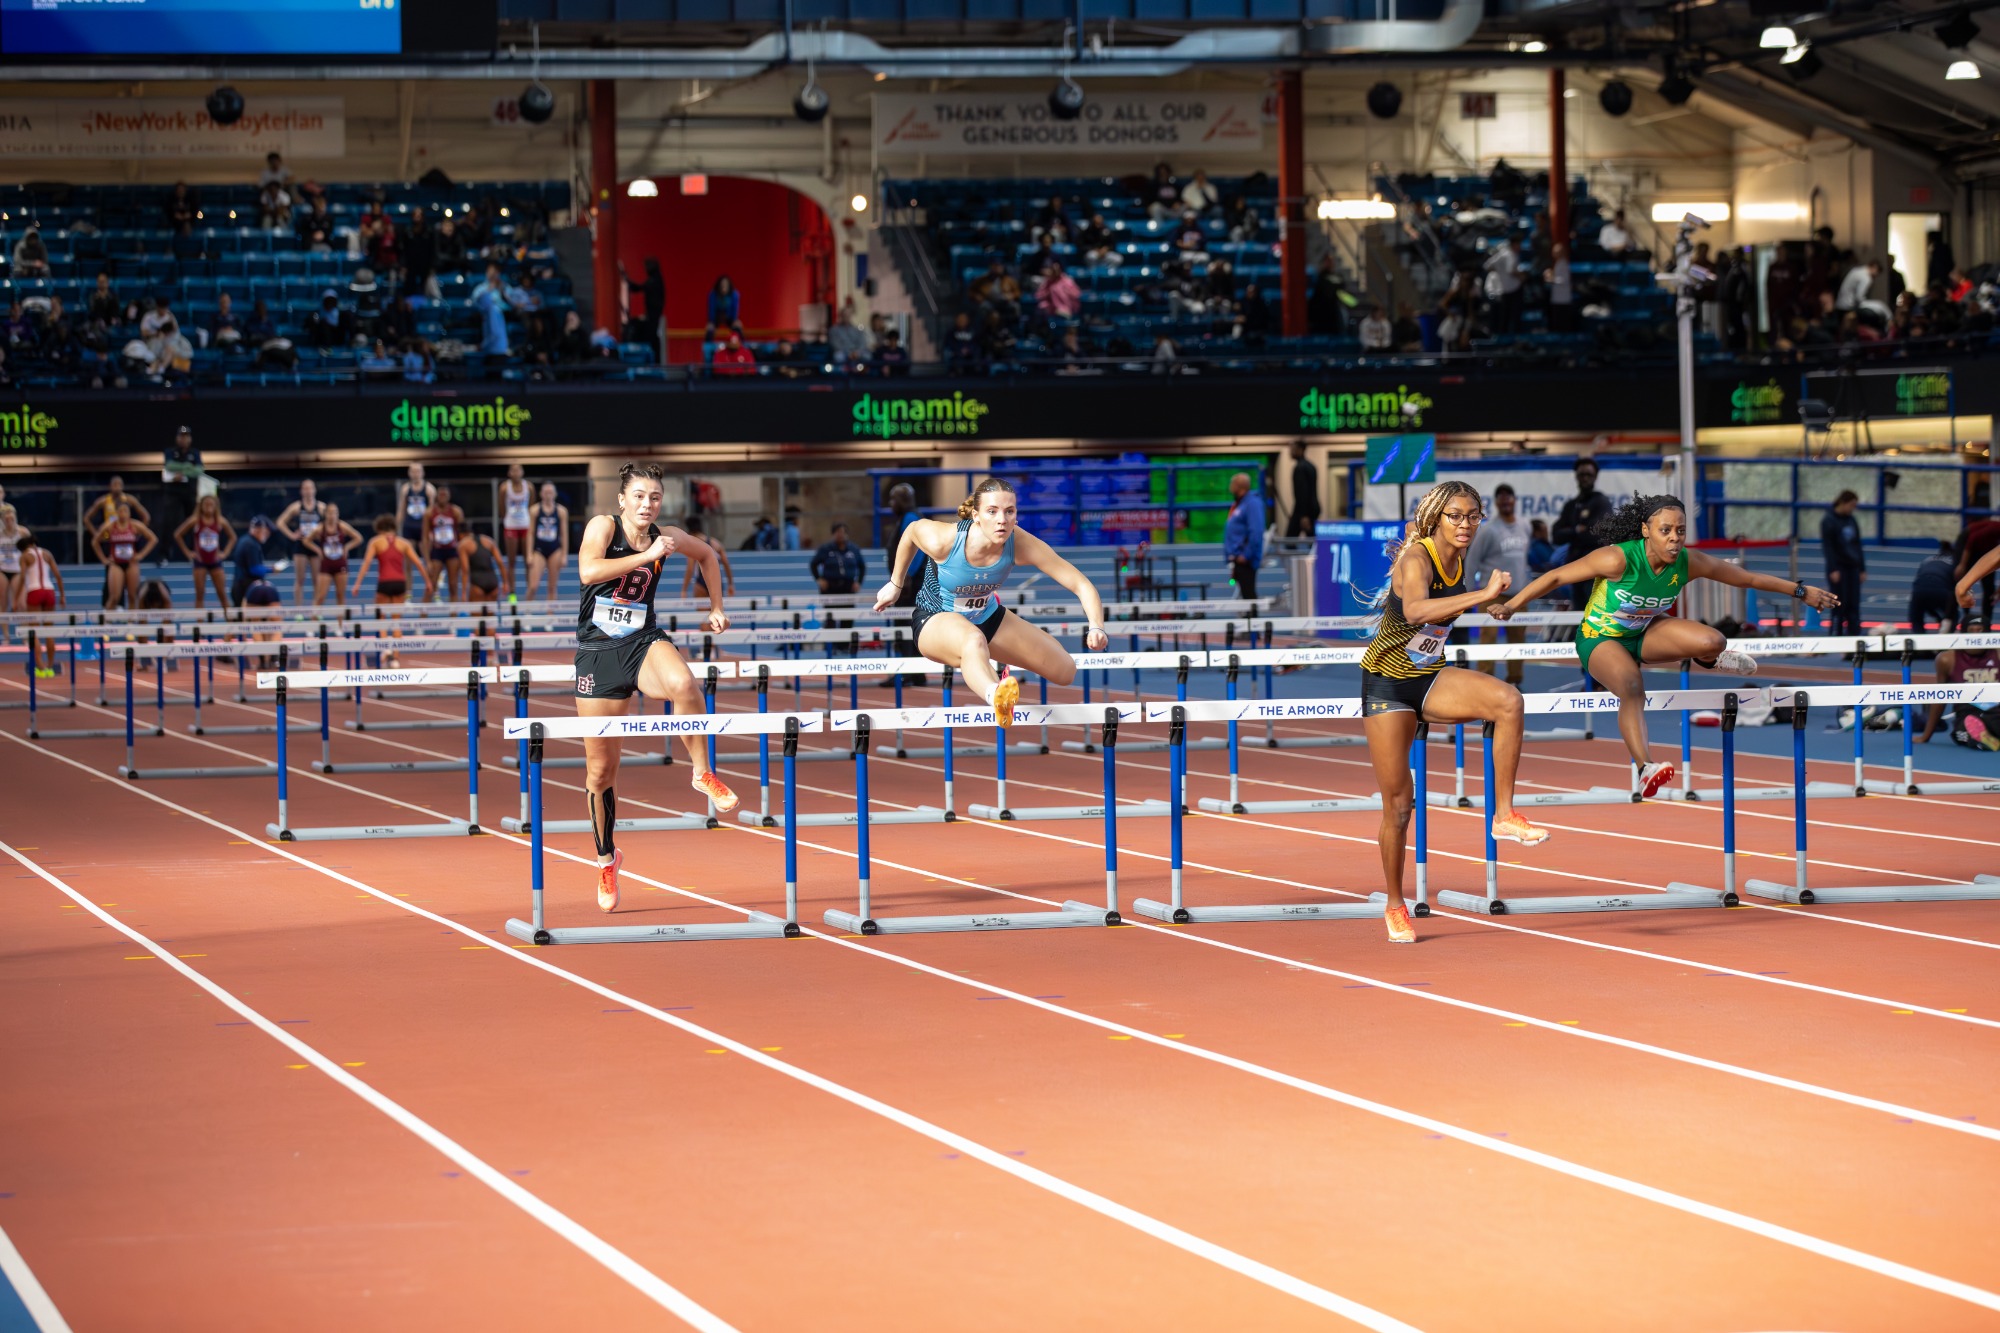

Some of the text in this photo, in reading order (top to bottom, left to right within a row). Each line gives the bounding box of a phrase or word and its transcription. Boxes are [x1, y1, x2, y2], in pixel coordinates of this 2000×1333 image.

[935, 104, 1006, 121] THANK
[1017, 103, 1044, 121] YO
[1114, 103, 1150, 121] ALL
[1160, 102, 1206, 121] OUR
[963, 125, 1179, 144] GENEROUS DONORS
[853, 390, 977, 438] dynamic
[1299, 385, 1422, 432] dynamic
[390, 396, 520, 445] dynamic
[391, 428, 520, 441] PRODUCTIONS
[853, 422, 978, 435] PRODUCTIONS
[1614, 589, 1678, 608] ESSE
[607, 608, 632, 624] 154
[1033, 607, 1066, 615] UCS
[1744, 643, 1761, 651] THE
[1083, 656, 1124, 665] ARMORY
[1293, 652, 1354, 661] THE ARMORY
[824, 663, 888, 672] THE ARMORY
[345, 674, 411, 683] THE ARMORY
[1880, 690, 1963, 701] THE ARMORY
[1570, 698, 1594, 709] THE
[1258, 704, 1344, 716] THE ARMORY
[945, 713, 969, 723] THE
[621, 720, 709, 732] THE ARMORY
